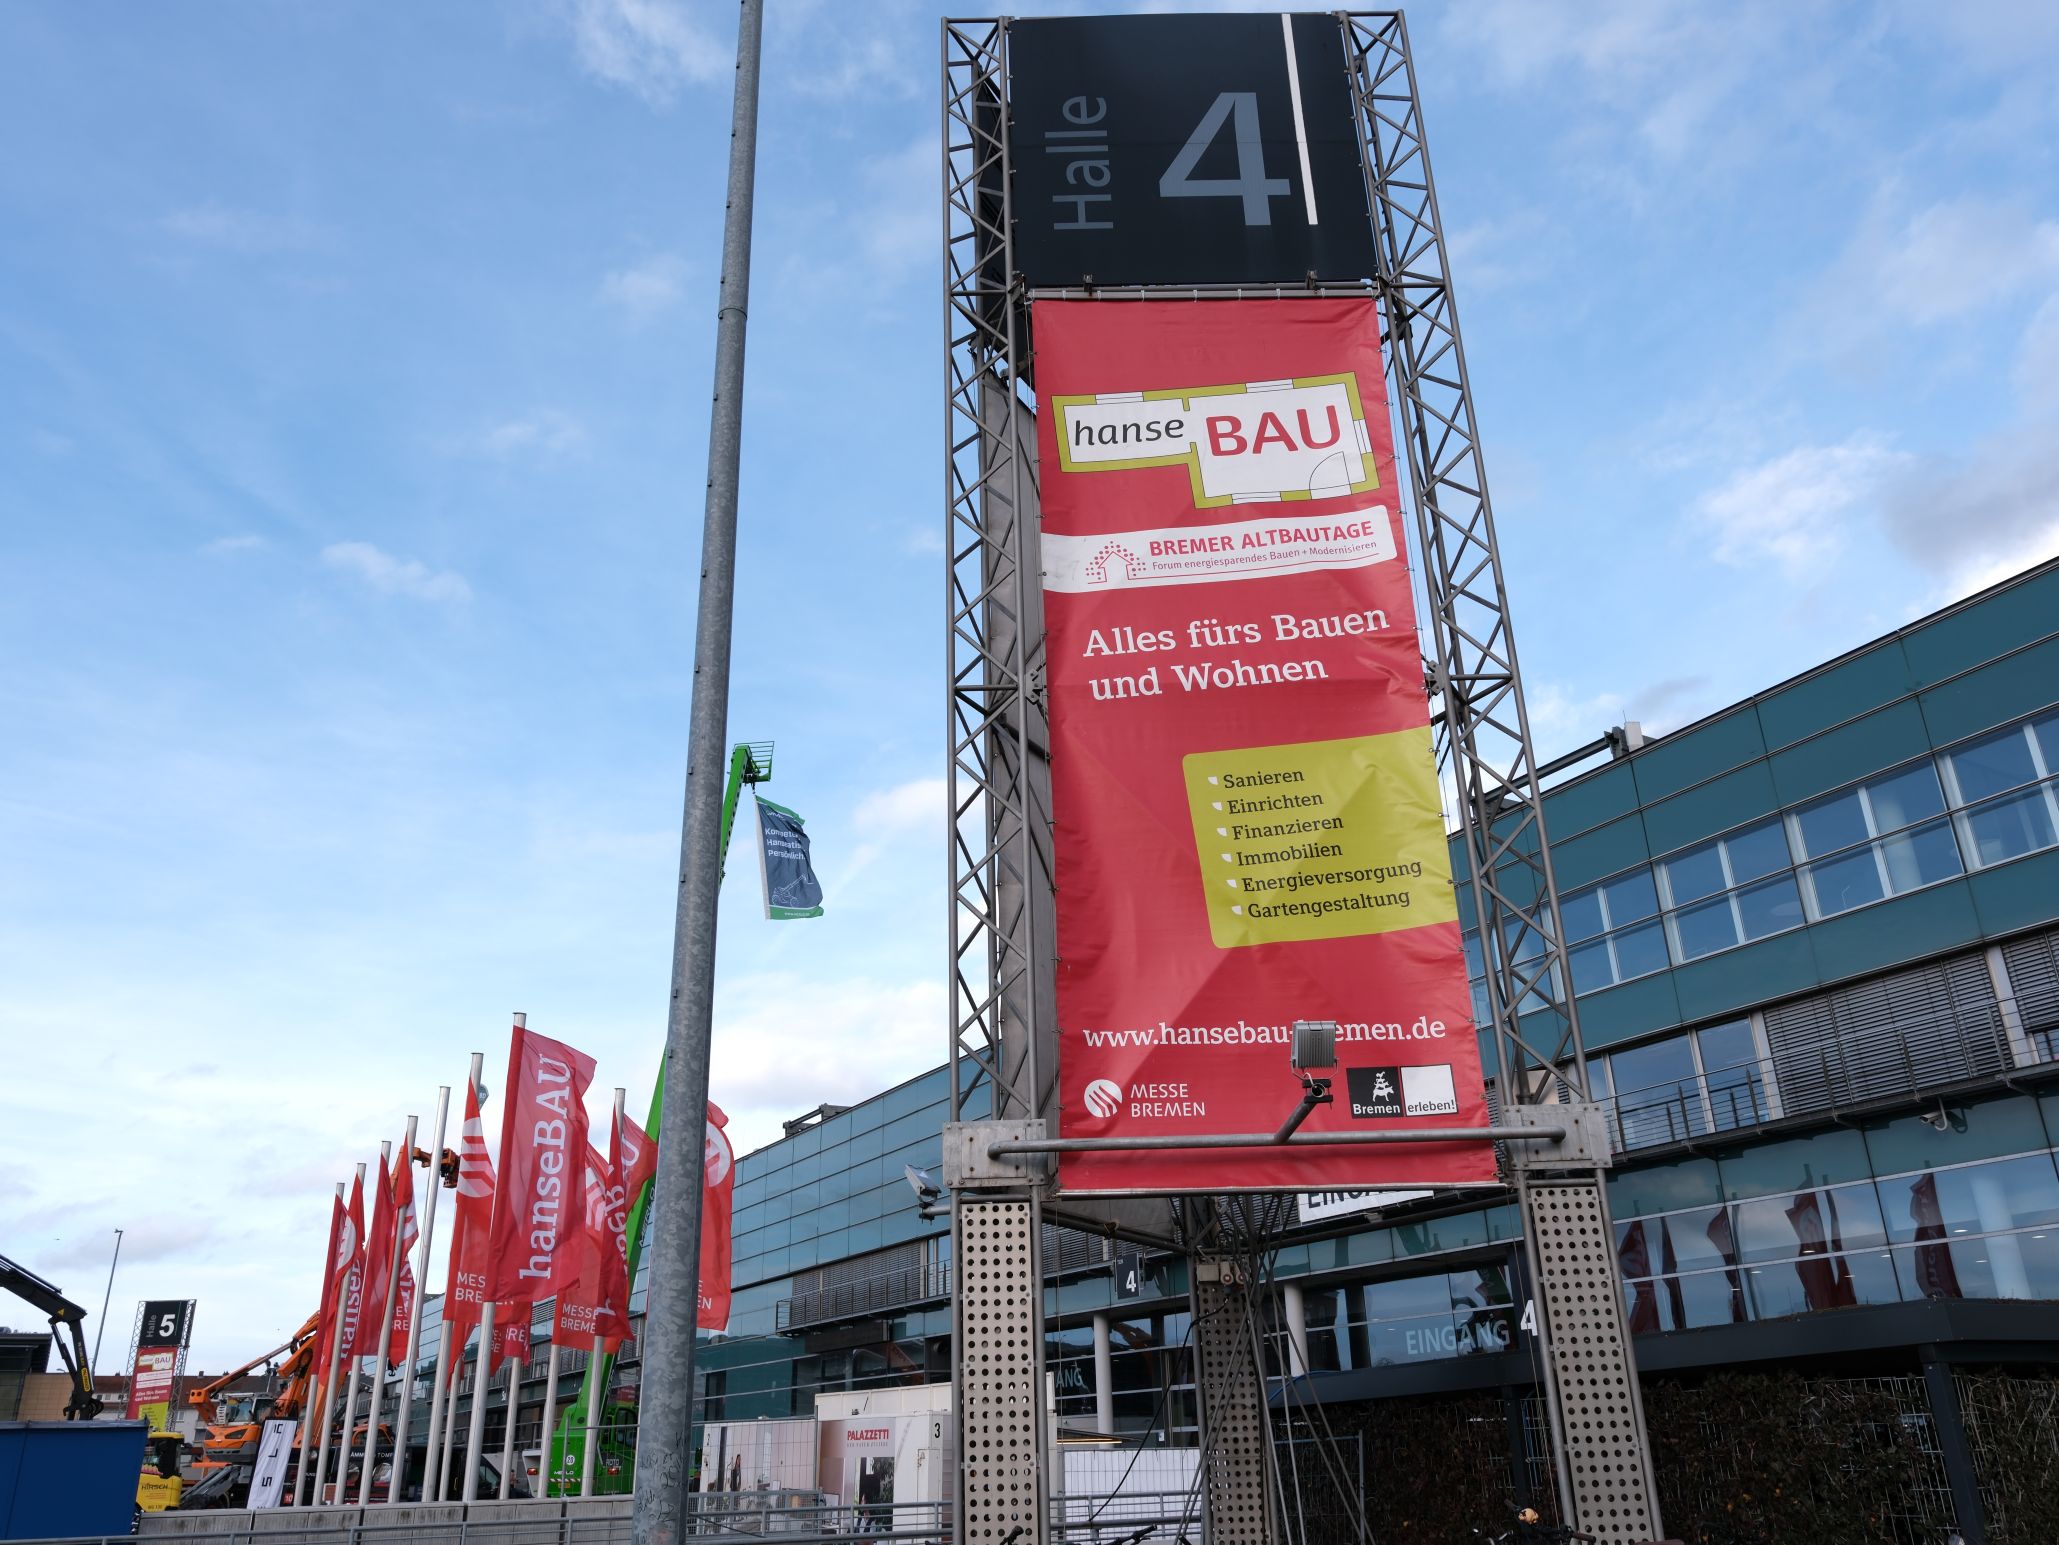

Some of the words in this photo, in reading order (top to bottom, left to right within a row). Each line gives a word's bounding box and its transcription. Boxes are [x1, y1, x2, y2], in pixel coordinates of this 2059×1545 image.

[1044, 95, 1114, 230] Halle
[1159, 92, 1291, 226] 4
[1074, 419, 1185, 446] hanse
[1206, 405, 1341, 457] BAU
[1149, 536, 1235, 558] BREMER
[1241, 520, 1374, 551] ALTBAUTAGE
[1152, 560, 1183, 570] Forum
[1184, 552, 1268, 570] energiesparendes
[1269, 549, 1300, 561] Bauen
[1309, 541, 1378, 556] Modernisieren
[1083, 627, 1176, 658] Alles
[1187, 618, 1262, 648] fürs
[1271, 608, 1390, 641] Bauen
[1089, 667, 1162, 701] und
[1171, 659, 1329, 692] Wohnen
[1223, 769, 1305, 789] Sanieren
[1228, 792, 1324, 815] Einrichten
[1232, 815, 1345, 841] Finanzieren
[1236, 842, 1344, 867] Immobilien
[1242, 860, 1422, 893] Energieversorgung
[1248, 890, 1410, 918] Gartengestaltung
[1130, 1083, 1189, 1099] MESSE
[1131, 1102, 1206, 1117] BREMEN
[1353, 1103, 1400, 1115] Bremen
[1407, 1099, 1455, 1113] erleben!
[519, 1054, 572, 1279] hanseBAU
[457, 1271, 486, 1288] MES
[1126, 1270, 1137, 1293] 4
[146, 1314, 157, 1338] Halle
[159, 1313, 176, 1337] 5
[560, 1316, 596, 1334] BREME
[1519, 1299, 1539, 1337] 4
[1405, 1319, 1511, 1355] EINGANG
[1056, 1367, 1083, 1388] ANG
[847, 1429, 889, 1441] PALAZZETTI
[934, 1422, 941, 1439] 3
